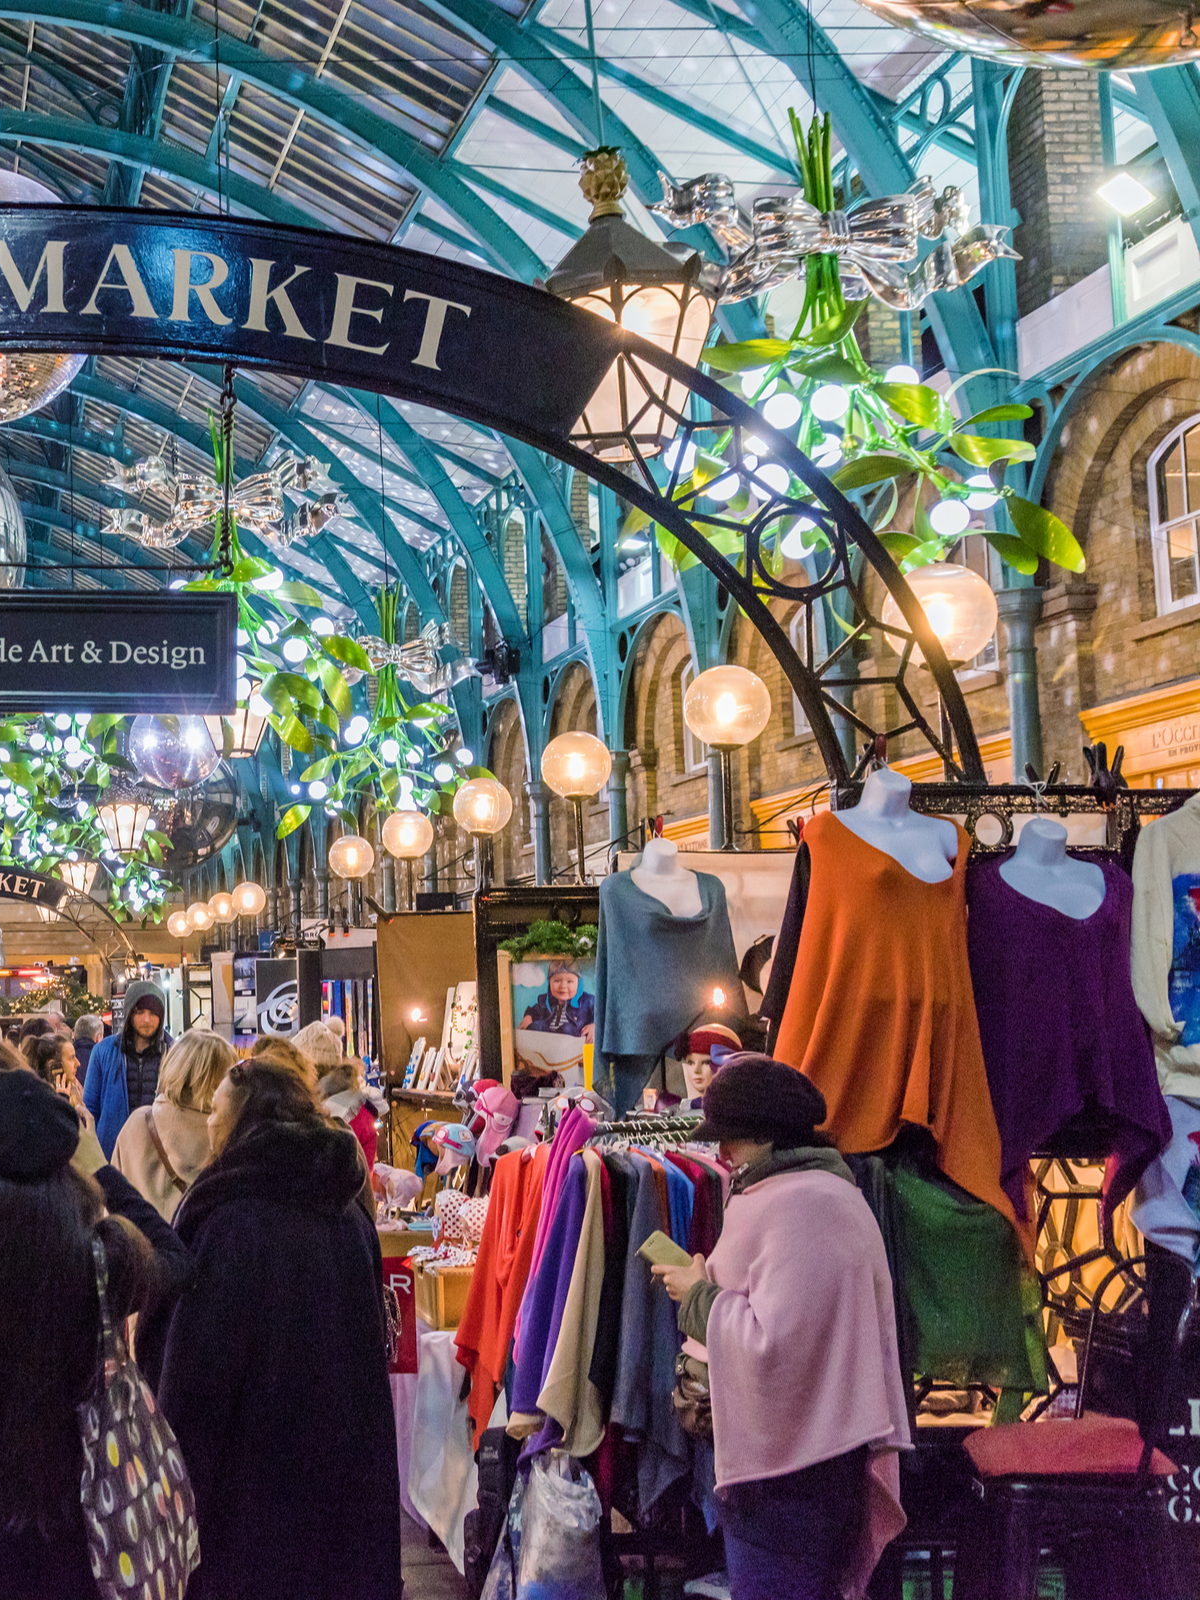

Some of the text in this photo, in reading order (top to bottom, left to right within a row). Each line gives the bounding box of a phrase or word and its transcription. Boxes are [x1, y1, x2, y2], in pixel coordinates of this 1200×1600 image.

[28, 639, 75, 664] Art
[80, 640, 102, 665] &
[109, 639, 207, 670] Design
[1152, 724, 1200, 749] L'OCCI
